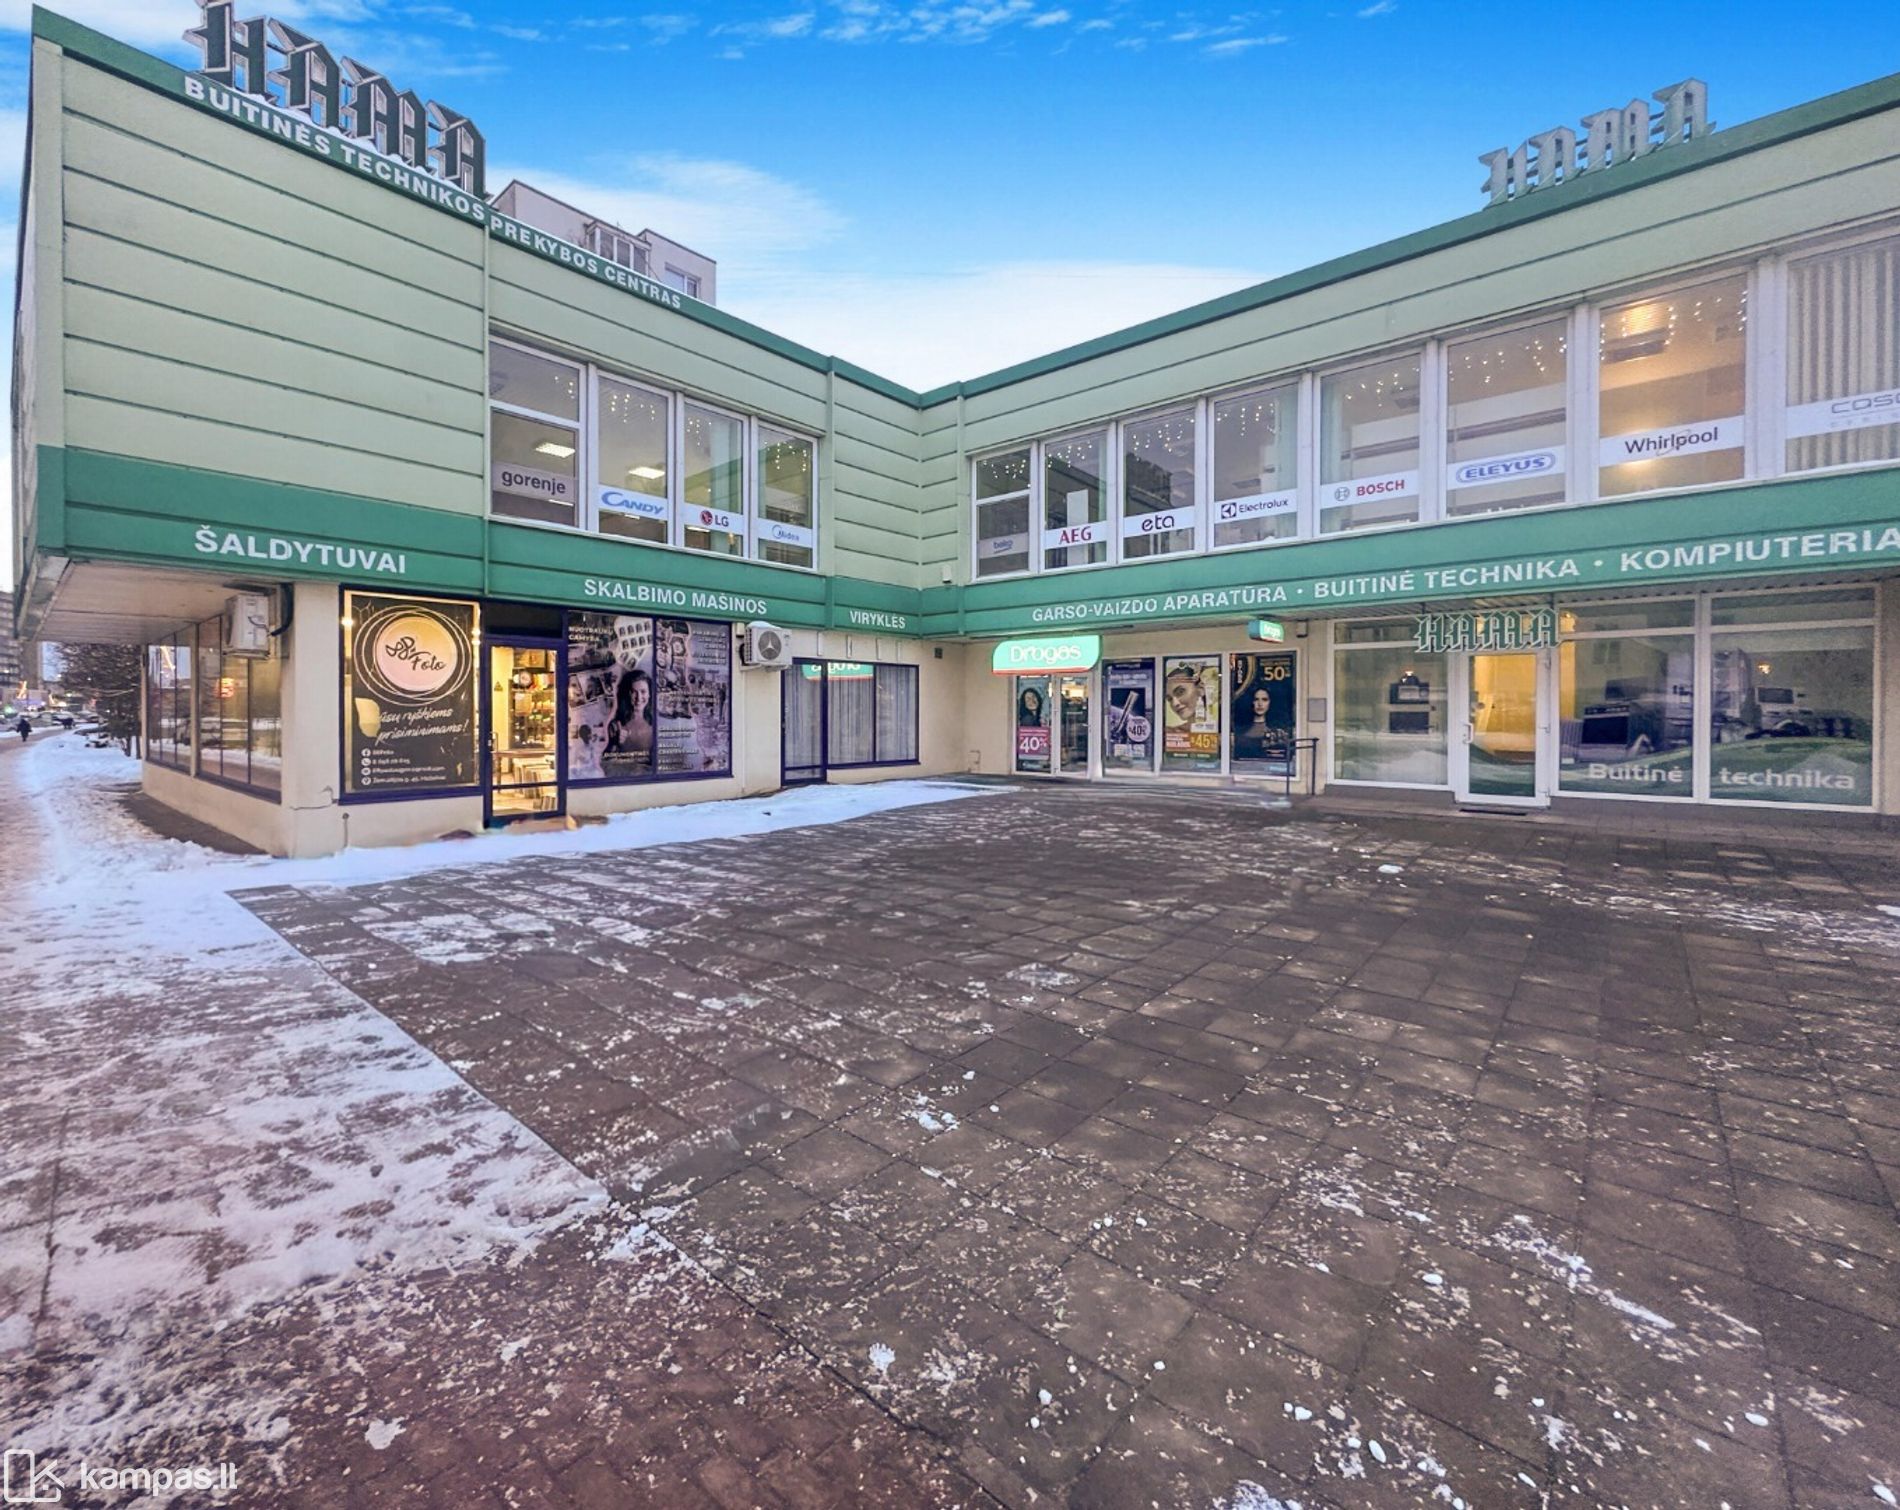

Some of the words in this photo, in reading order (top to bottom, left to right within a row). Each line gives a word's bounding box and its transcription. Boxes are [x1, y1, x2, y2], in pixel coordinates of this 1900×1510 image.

[185, 76, 331, 156] BUITINĖS
[340, 144, 485, 221] TECHNIKOS
[491, 214, 598, 275] PREKYBOS
[604, 266, 681, 309] CENTRAS
[1831, 392, 1900, 414] cas
[1624, 426, 1719, 454] Whirlpool
[1465, 456, 1546, 479] ELEYUS
[501, 469, 567, 496] gorenje
[1356, 479, 1405, 496] BOSCH
[601, 491, 664, 515] CANDY
[1238, 498, 1289, 514] Electrolux
[714, 514, 729, 527] LG
[1141, 513, 1175, 532] eta
[1059, 526, 1092, 544] AEG
[194, 524, 406, 574] ŠALDYTUVAI
[1032, 598, 1158, 622] GARSO-VAIZDO
[1163, 585, 1287, 611] APARATŪRA
[1313, 570, 1415, 599] BUITINĖ
[1424, 559, 1580, 588] TECHNIKA
[1620, 527, 1900, 572] KOMPIUTERIA
[584, 578, 686, 606] SKALBIMO
[692, 591, 768, 614] MAŠINOS
[850, 610, 906, 629] VIRYKLĖS
[1589, 762, 1684, 784] Buitinė
[1719, 766, 1856, 790] technika
